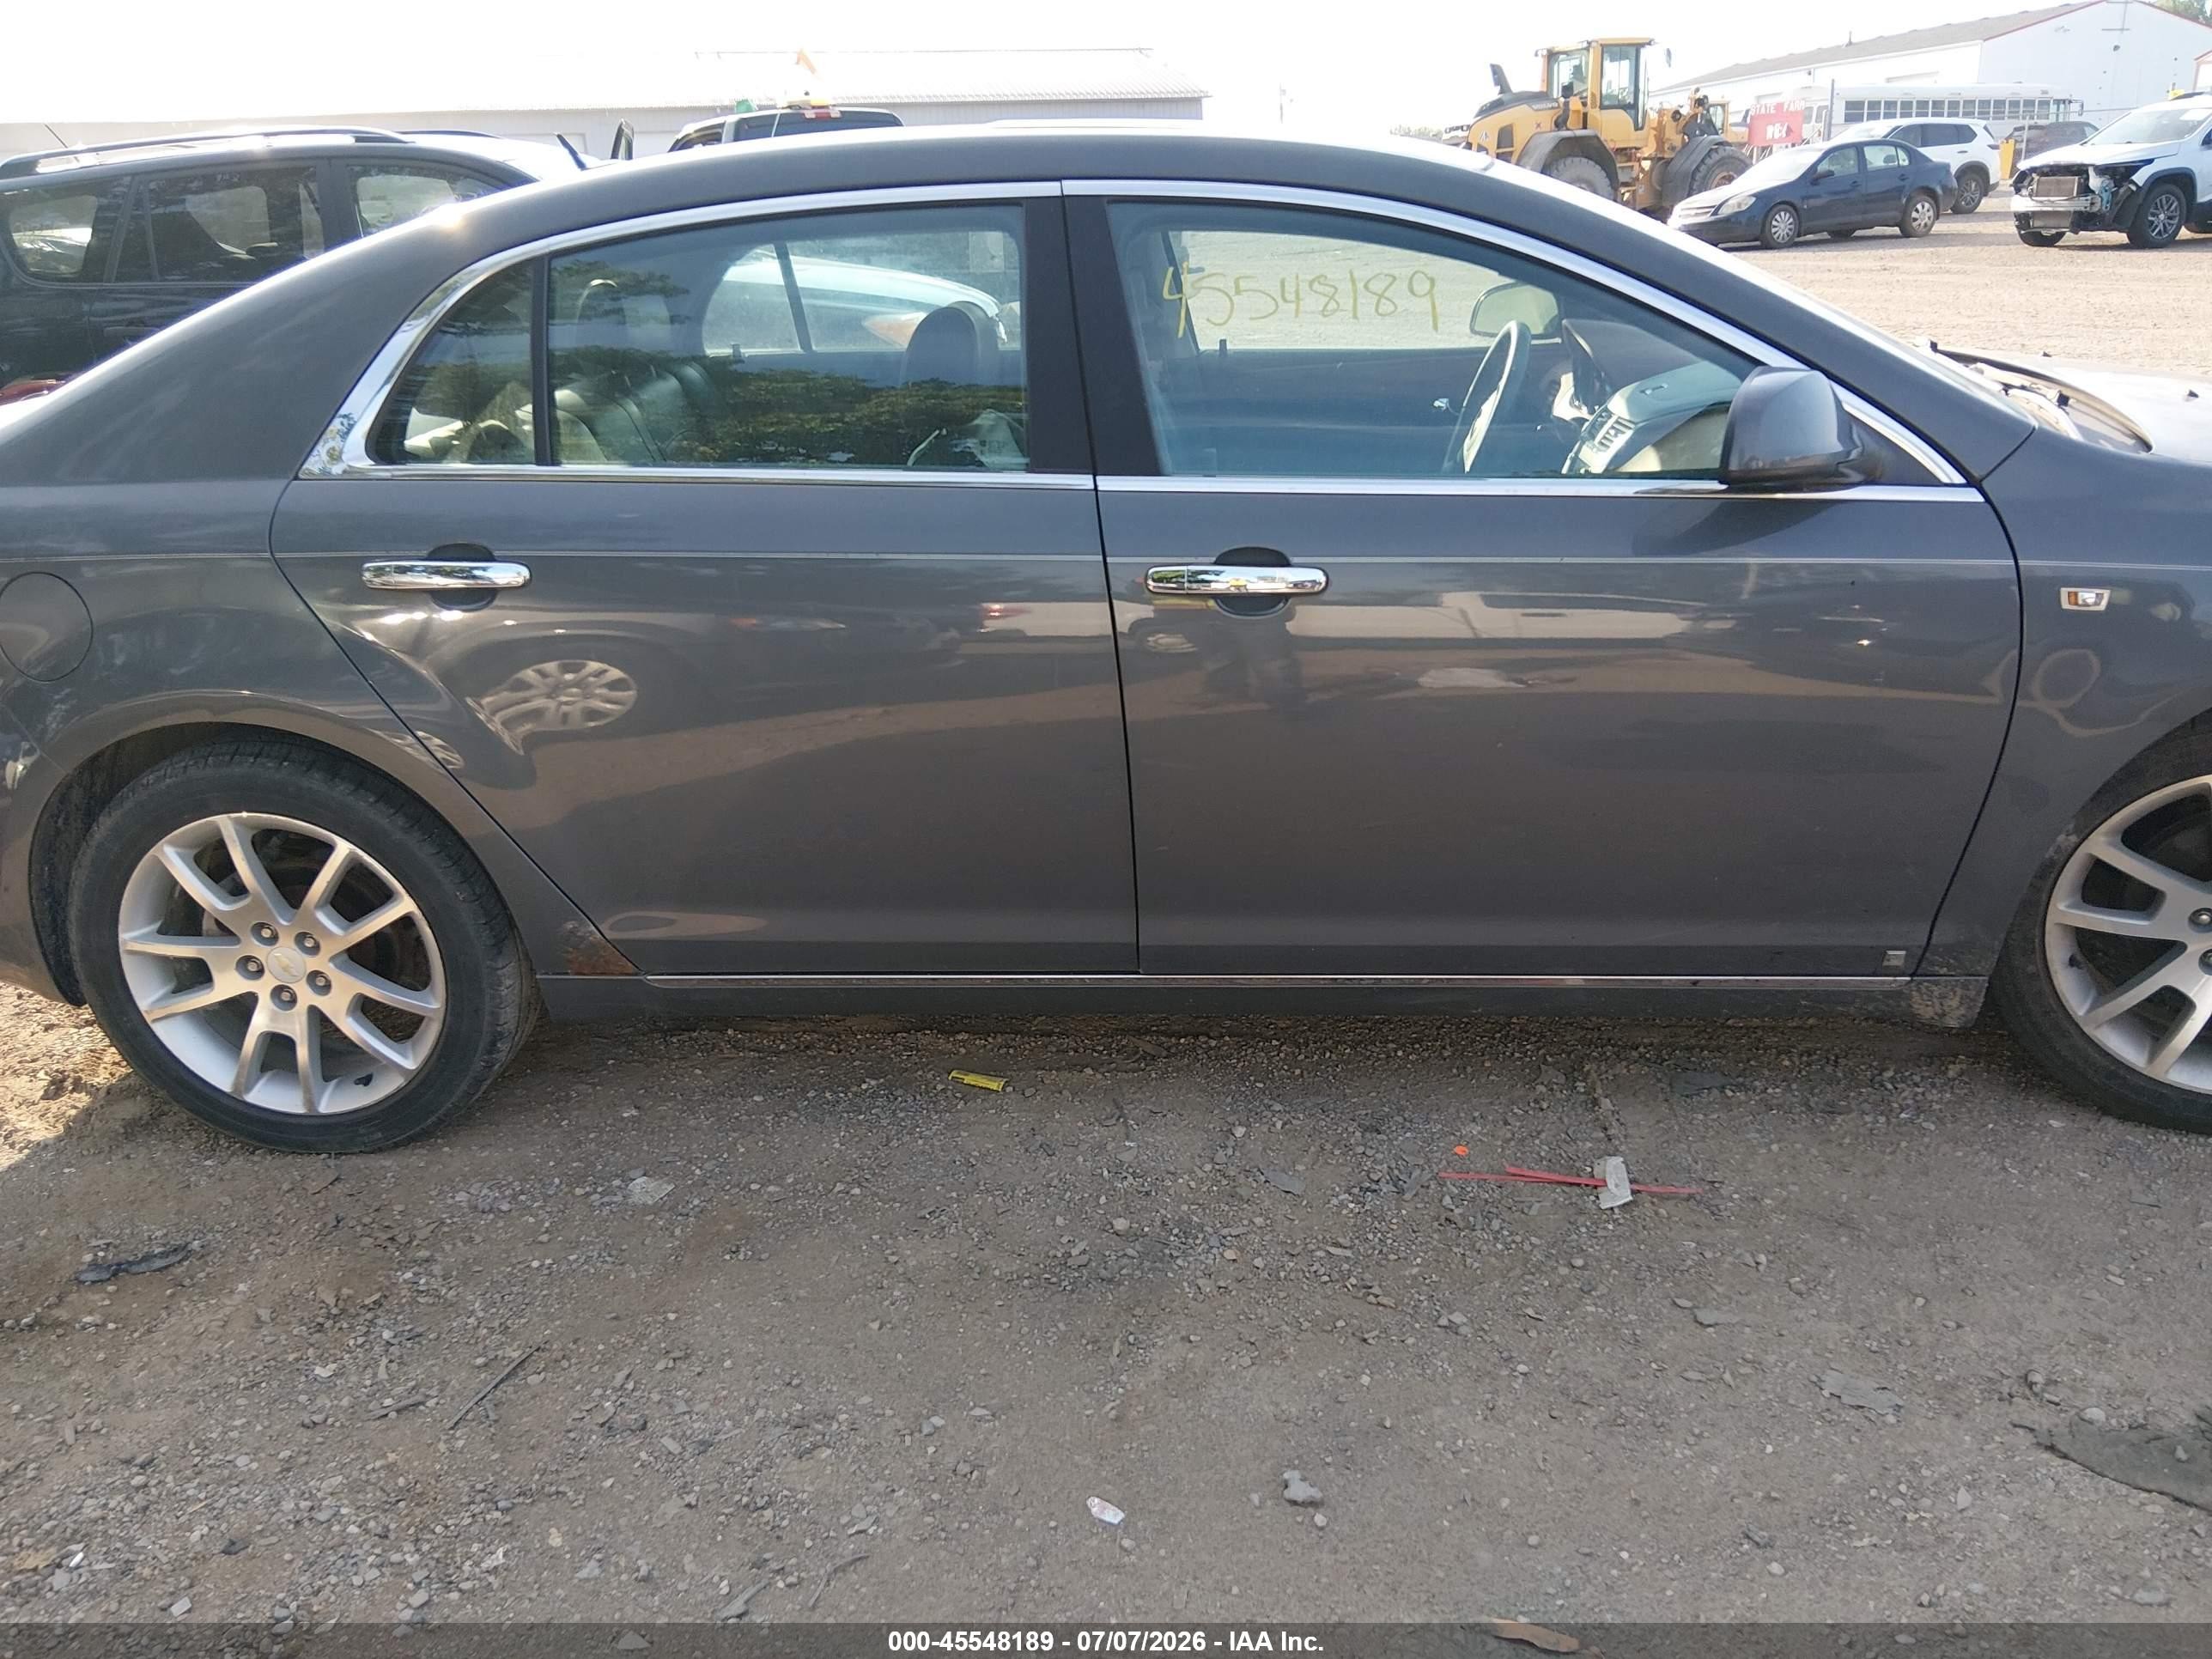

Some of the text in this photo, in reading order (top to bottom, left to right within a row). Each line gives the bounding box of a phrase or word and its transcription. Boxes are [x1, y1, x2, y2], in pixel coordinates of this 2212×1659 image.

[1751, 100, 1806, 116] STATE FARM
[1163, 260, 1439, 338] 45548189
